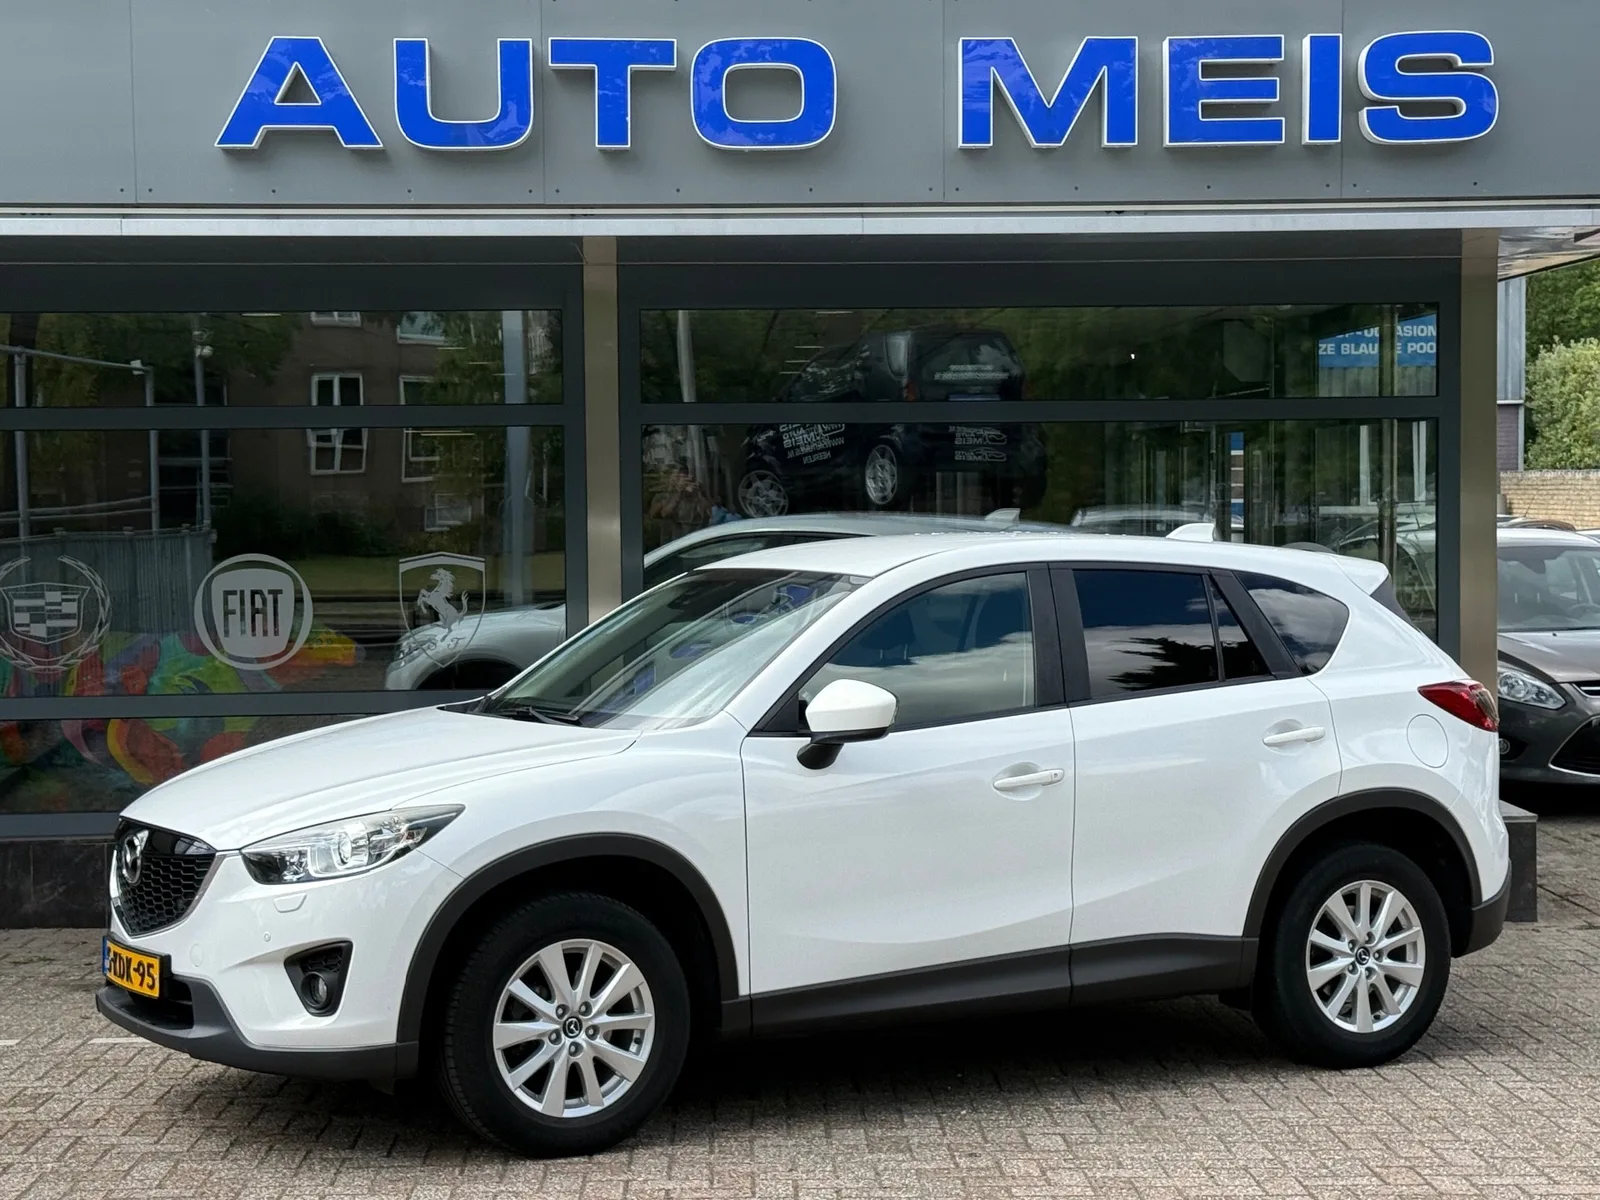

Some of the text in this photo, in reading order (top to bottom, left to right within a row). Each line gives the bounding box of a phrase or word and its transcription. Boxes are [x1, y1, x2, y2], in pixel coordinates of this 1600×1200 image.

[214, 30, 1500, 151] AUTO MEIS
[1340, 343, 1402, 355] BLAUE
[222, 589, 283, 638] FIAT
